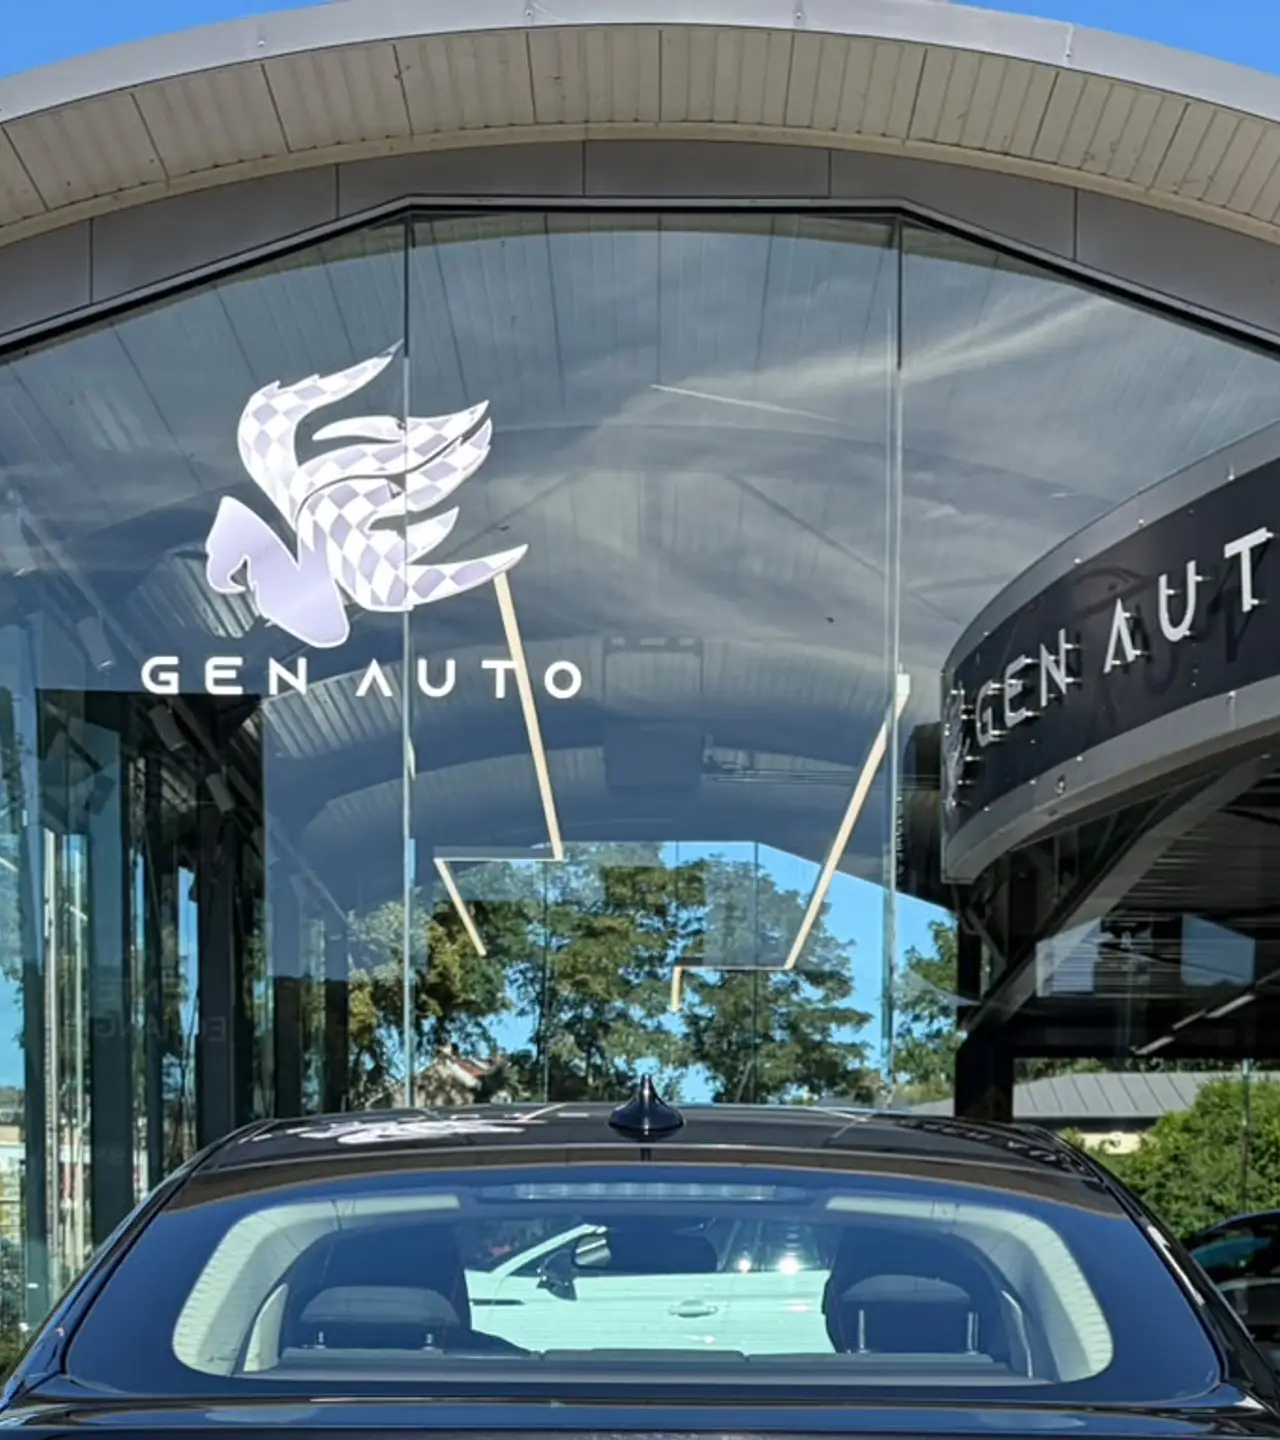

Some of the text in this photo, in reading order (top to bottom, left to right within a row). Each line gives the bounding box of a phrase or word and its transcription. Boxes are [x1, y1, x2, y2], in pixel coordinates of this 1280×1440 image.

[141, 655, 582, 699] GEN AUTO
[975, 627, 1067, 748] GEN
